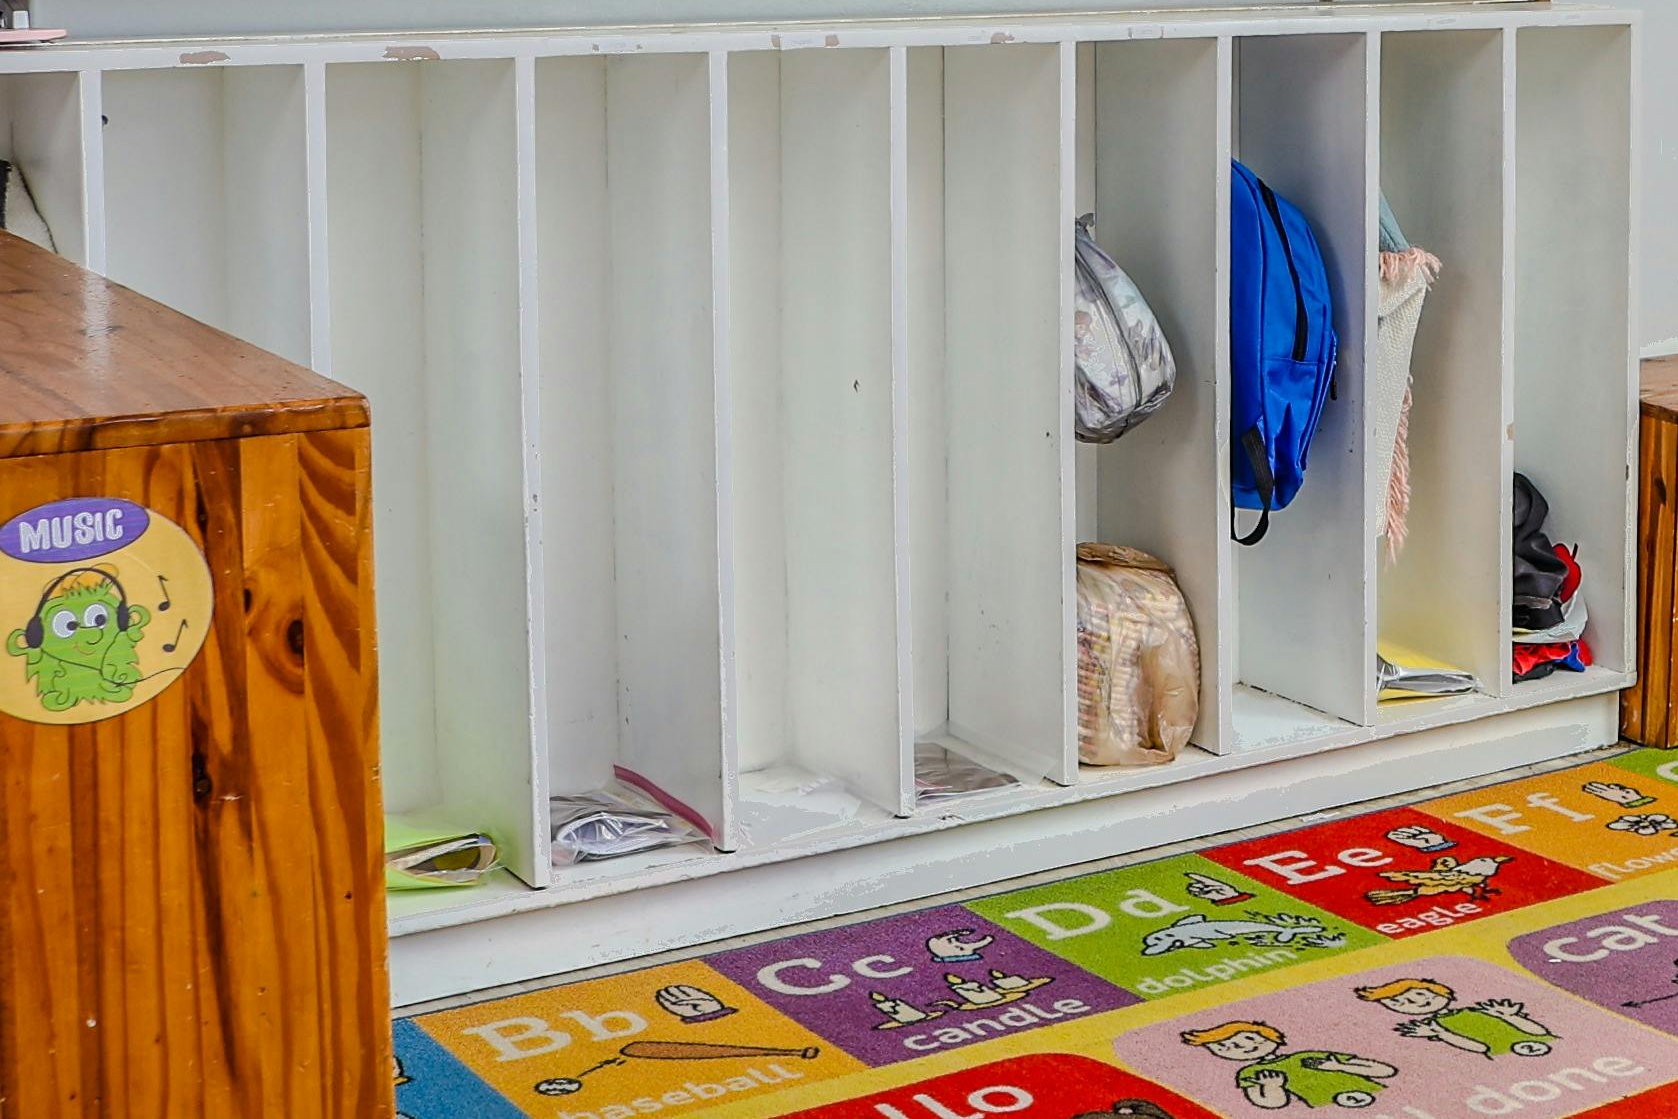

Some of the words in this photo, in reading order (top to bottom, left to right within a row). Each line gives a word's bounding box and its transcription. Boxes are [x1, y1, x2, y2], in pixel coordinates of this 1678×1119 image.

[19, 508, 123, 553] MUSIC
[1454, 792, 1597, 837] Ff
[1244, 843, 1393, 886] Ee
[1005, 888, 1189, 941] Dd
[1377, 898, 1483, 937] eagle
[755, 954, 914, 997] Cc
[1136, 948, 1297, 996] dolphin
[461, 1009, 649, 1062] Bb
[904, 994, 1090, 1052] candle
[558, 1064, 804, 1119] baseball
[1466, 1057, 1645, 1114] done
